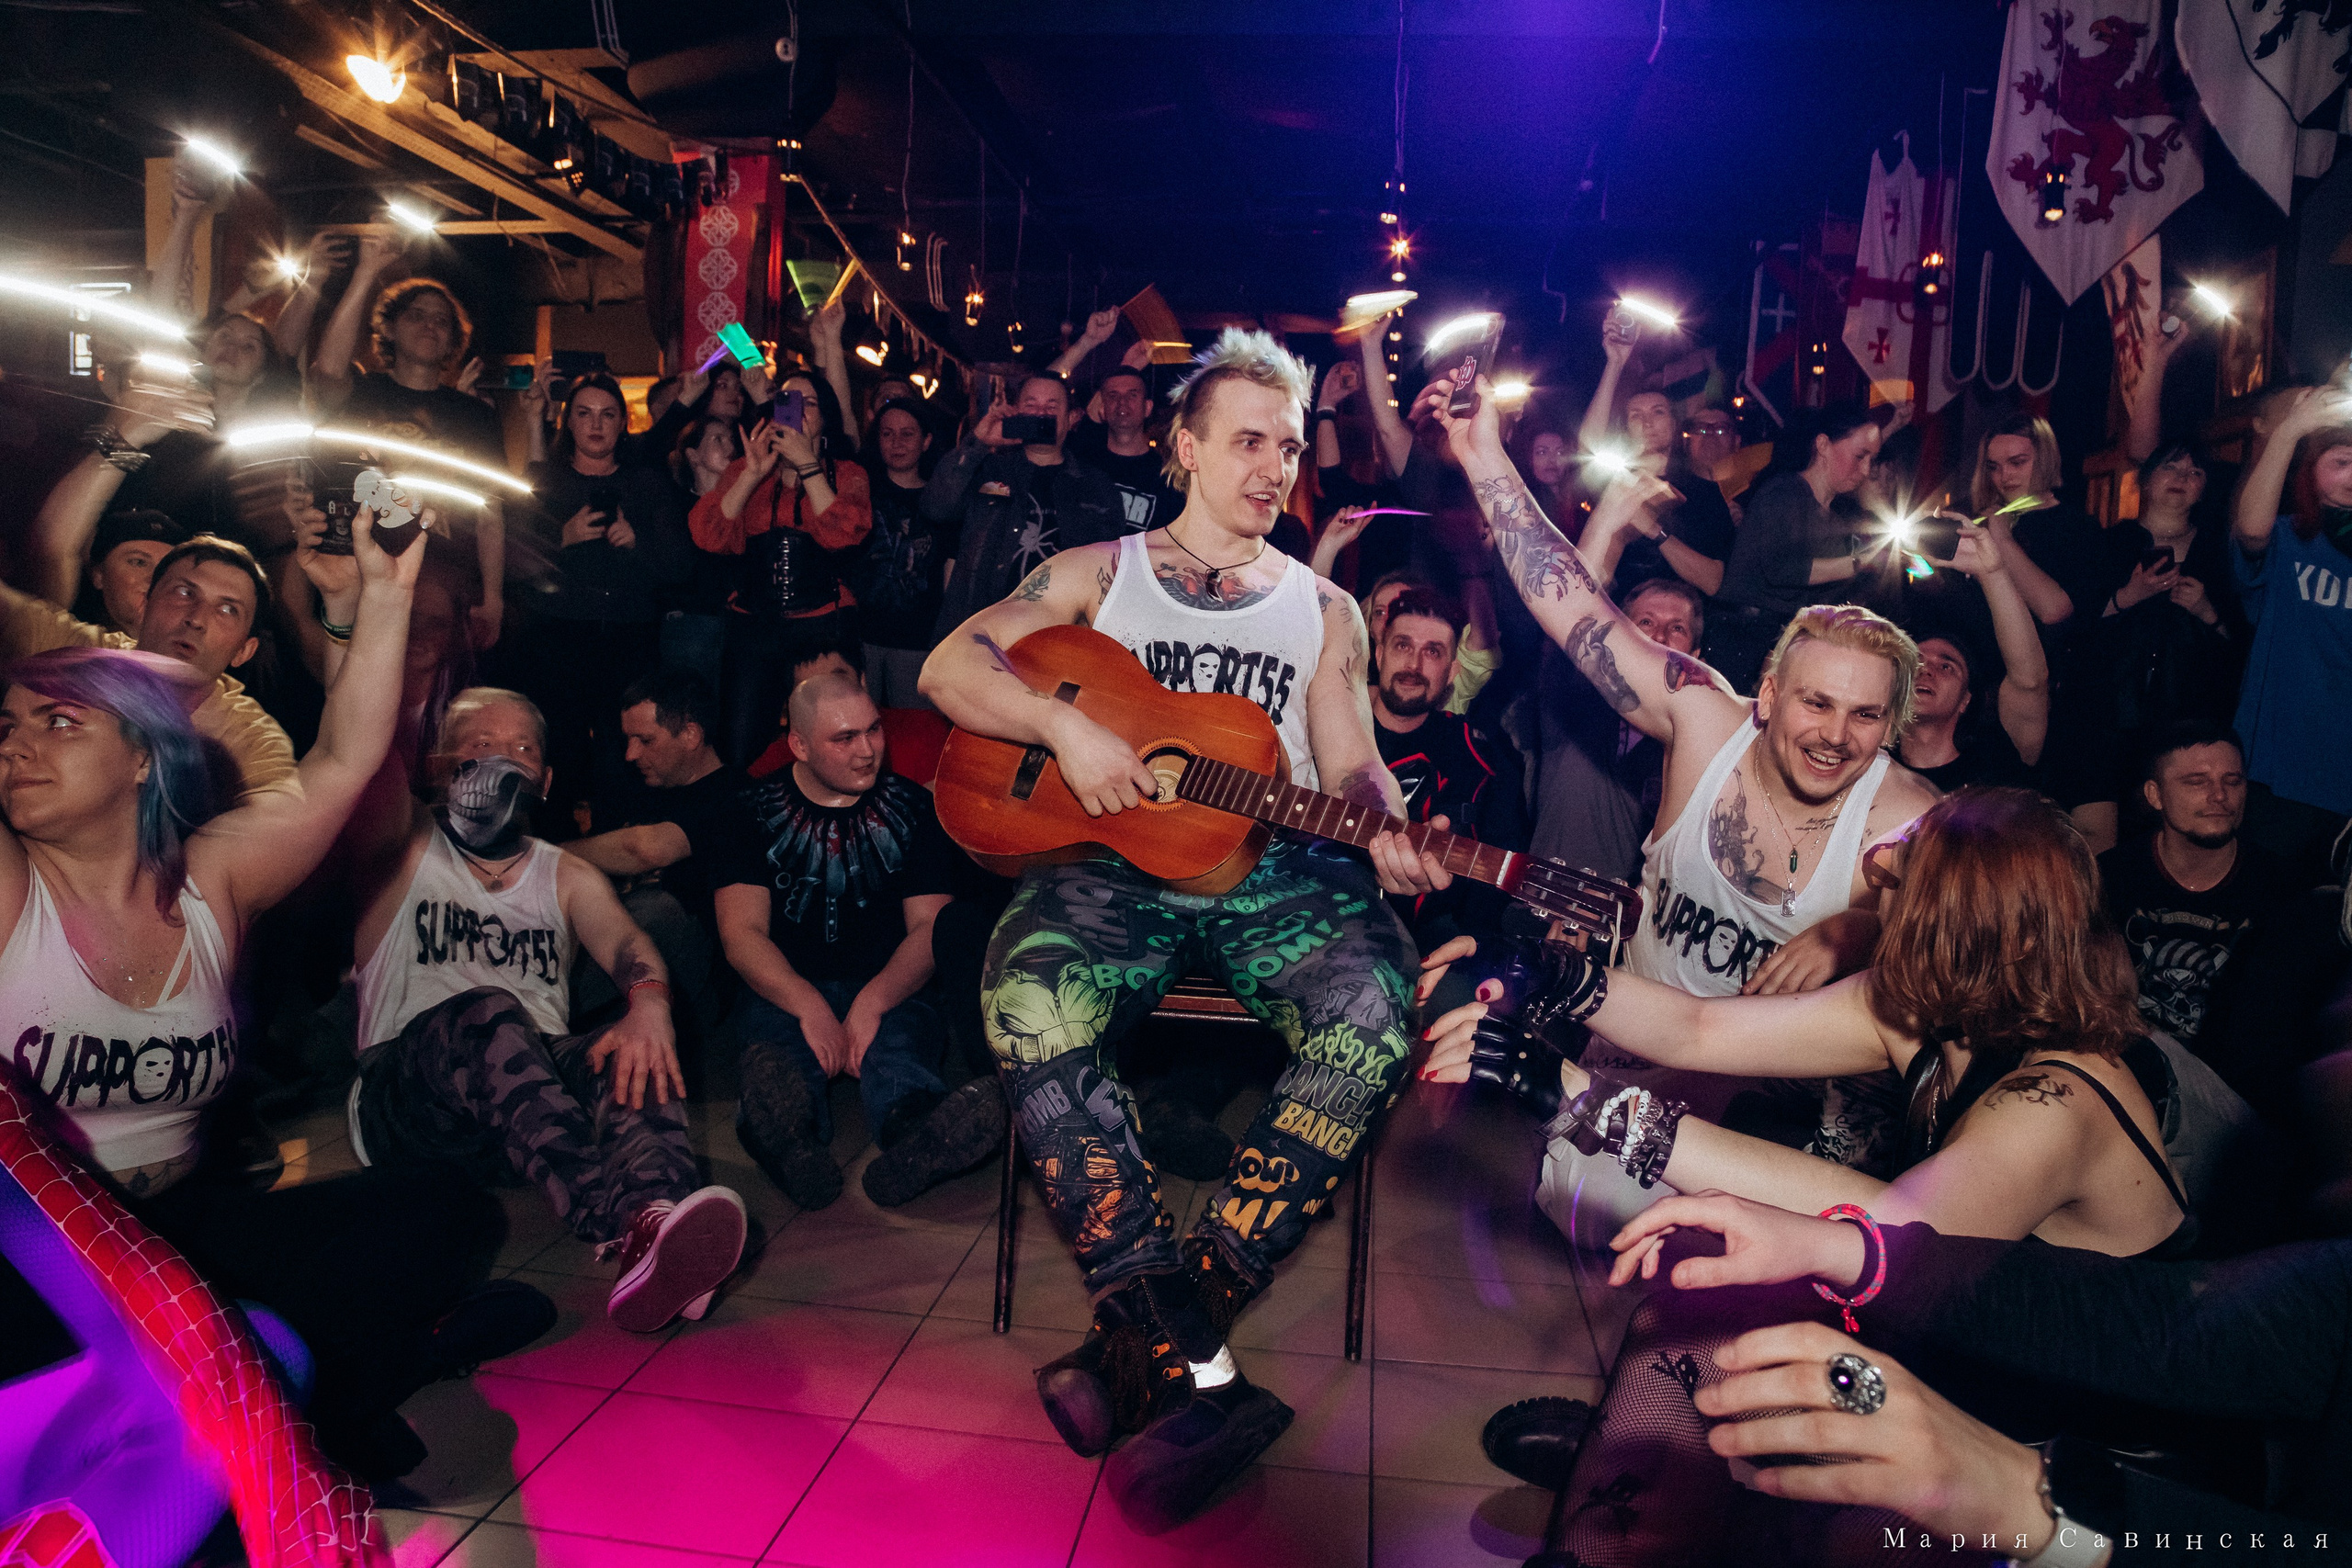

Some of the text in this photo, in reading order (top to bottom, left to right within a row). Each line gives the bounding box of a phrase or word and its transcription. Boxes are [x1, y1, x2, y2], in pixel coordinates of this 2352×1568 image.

[1130, 640, 1295, 726] PPORT55
[415, 898, 560, 987] SUPPORT55
[1272, 1101, 1361, 1161] BANG!
